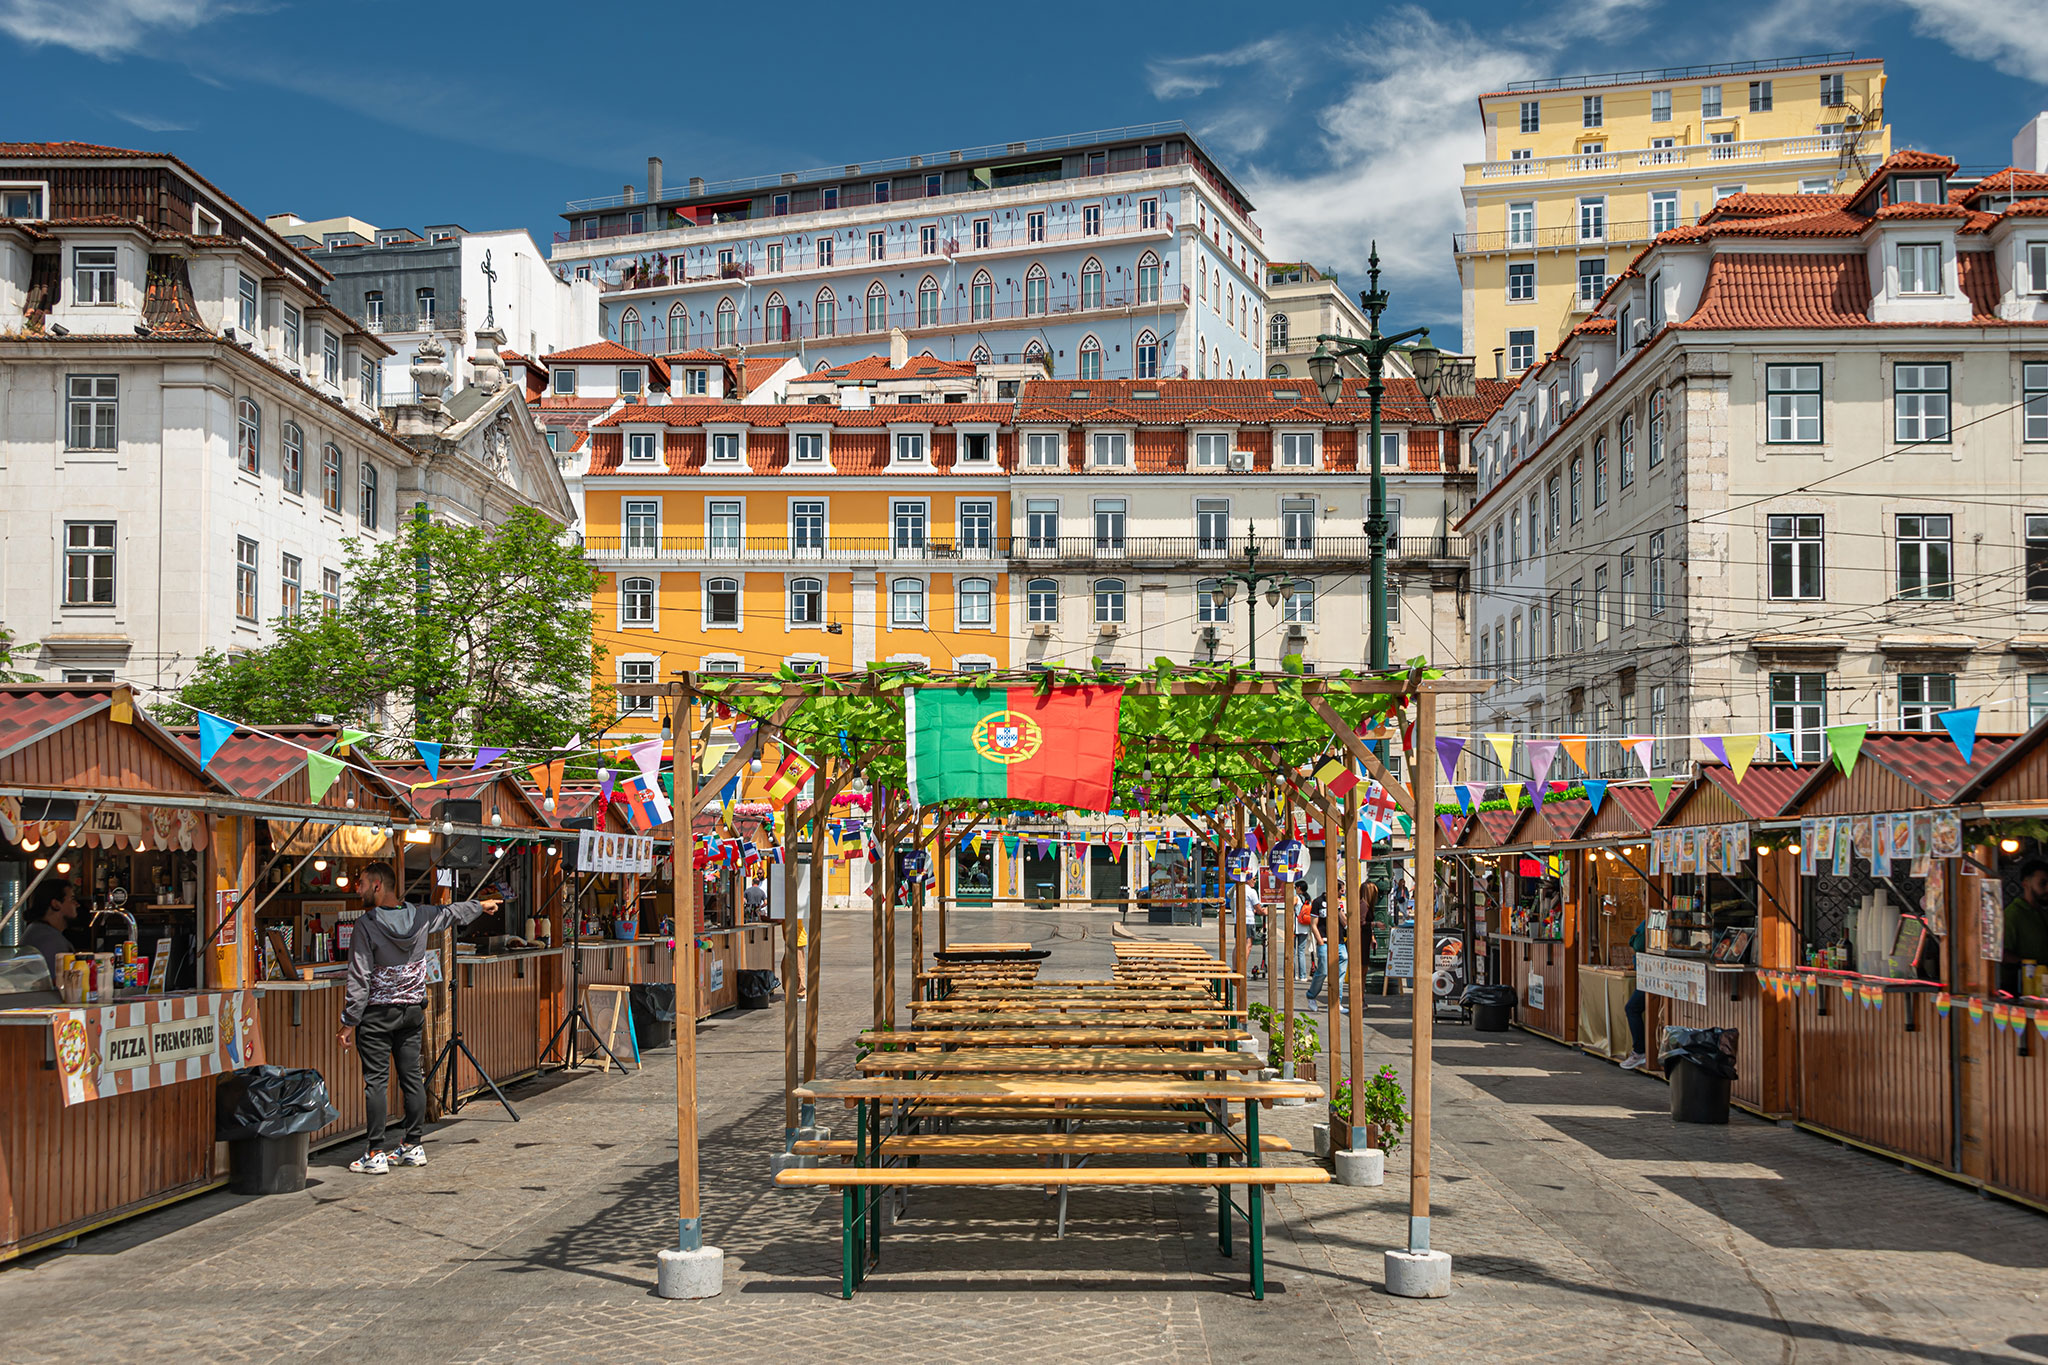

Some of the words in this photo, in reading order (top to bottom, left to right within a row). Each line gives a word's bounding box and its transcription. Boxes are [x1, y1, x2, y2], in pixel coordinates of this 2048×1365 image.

[91, 811, 122, 830] PIZZA
[110, 1037, 147, 1061] PIZZA
[154, 1029, 191, 1053] FRENCH
[192, 1025, 214, 1047] FRIES
